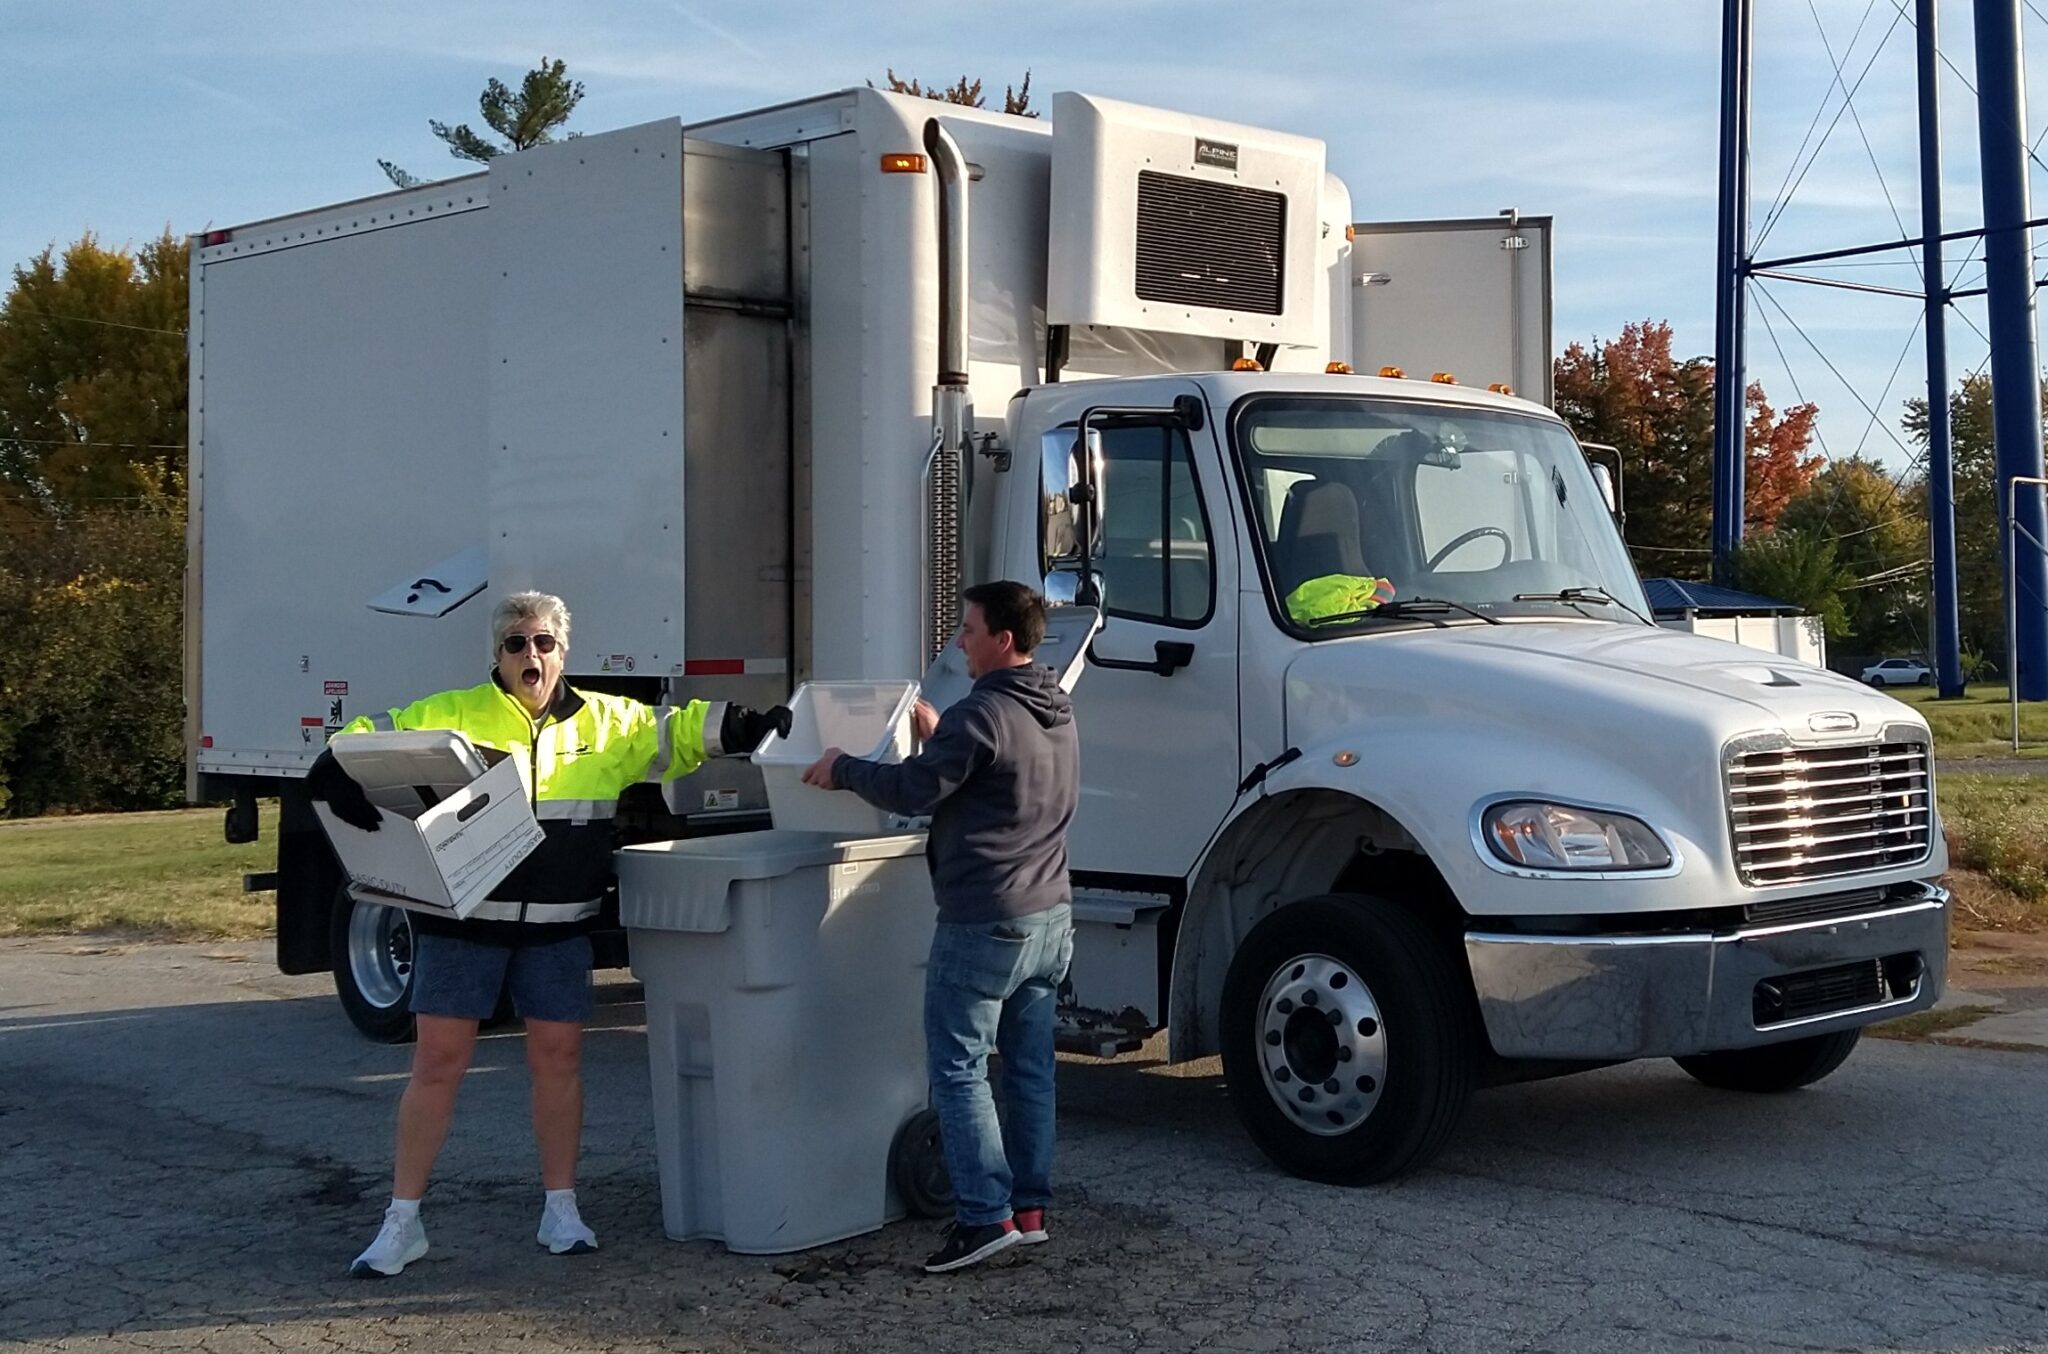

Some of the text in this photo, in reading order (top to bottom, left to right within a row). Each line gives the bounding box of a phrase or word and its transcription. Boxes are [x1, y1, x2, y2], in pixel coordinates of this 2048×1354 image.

[1199, 146, 1238, 158] ALPINE
[522, 830, 543, 853] BASIC
[504, 850, 523, 872] DUTY
